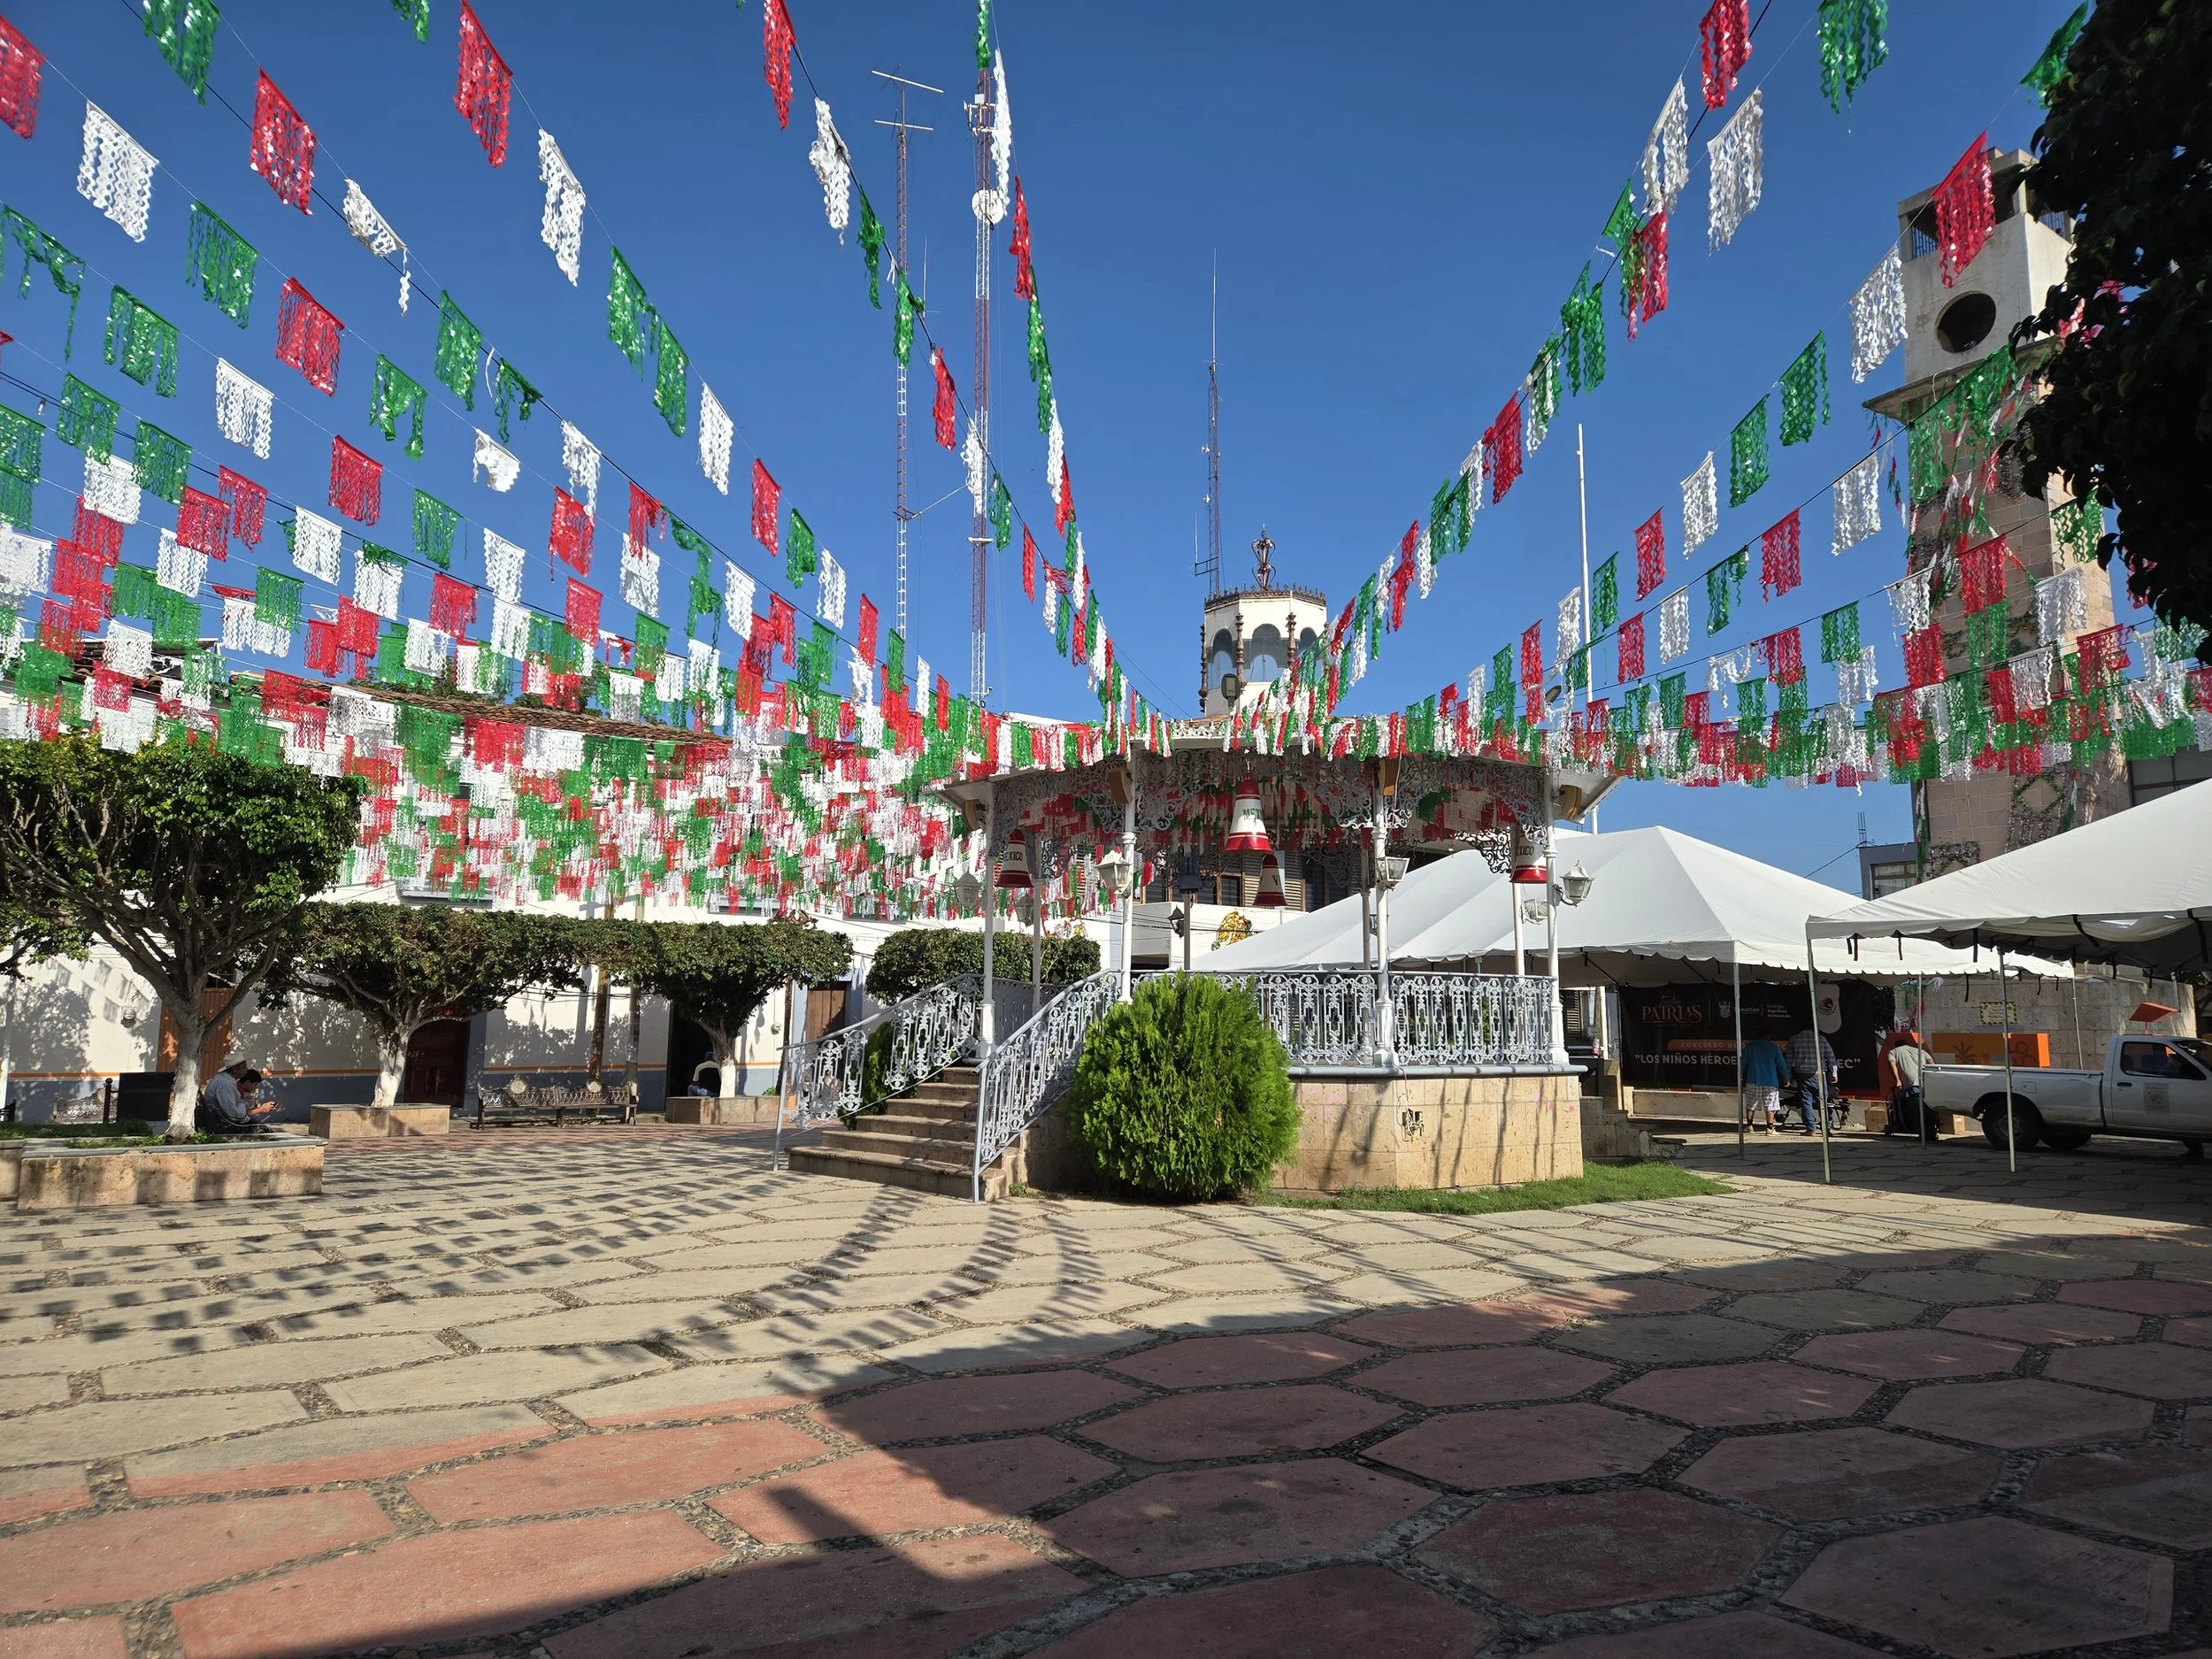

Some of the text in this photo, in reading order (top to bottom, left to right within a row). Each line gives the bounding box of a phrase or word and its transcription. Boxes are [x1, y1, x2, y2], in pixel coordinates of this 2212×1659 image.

[1004, 851, 1024, 861] EXICO
[1642, 1005, 1703, 1024] PATRIAS
[1635, 1052, 1738, 1065] "LOS NIÑOS HÉROE
